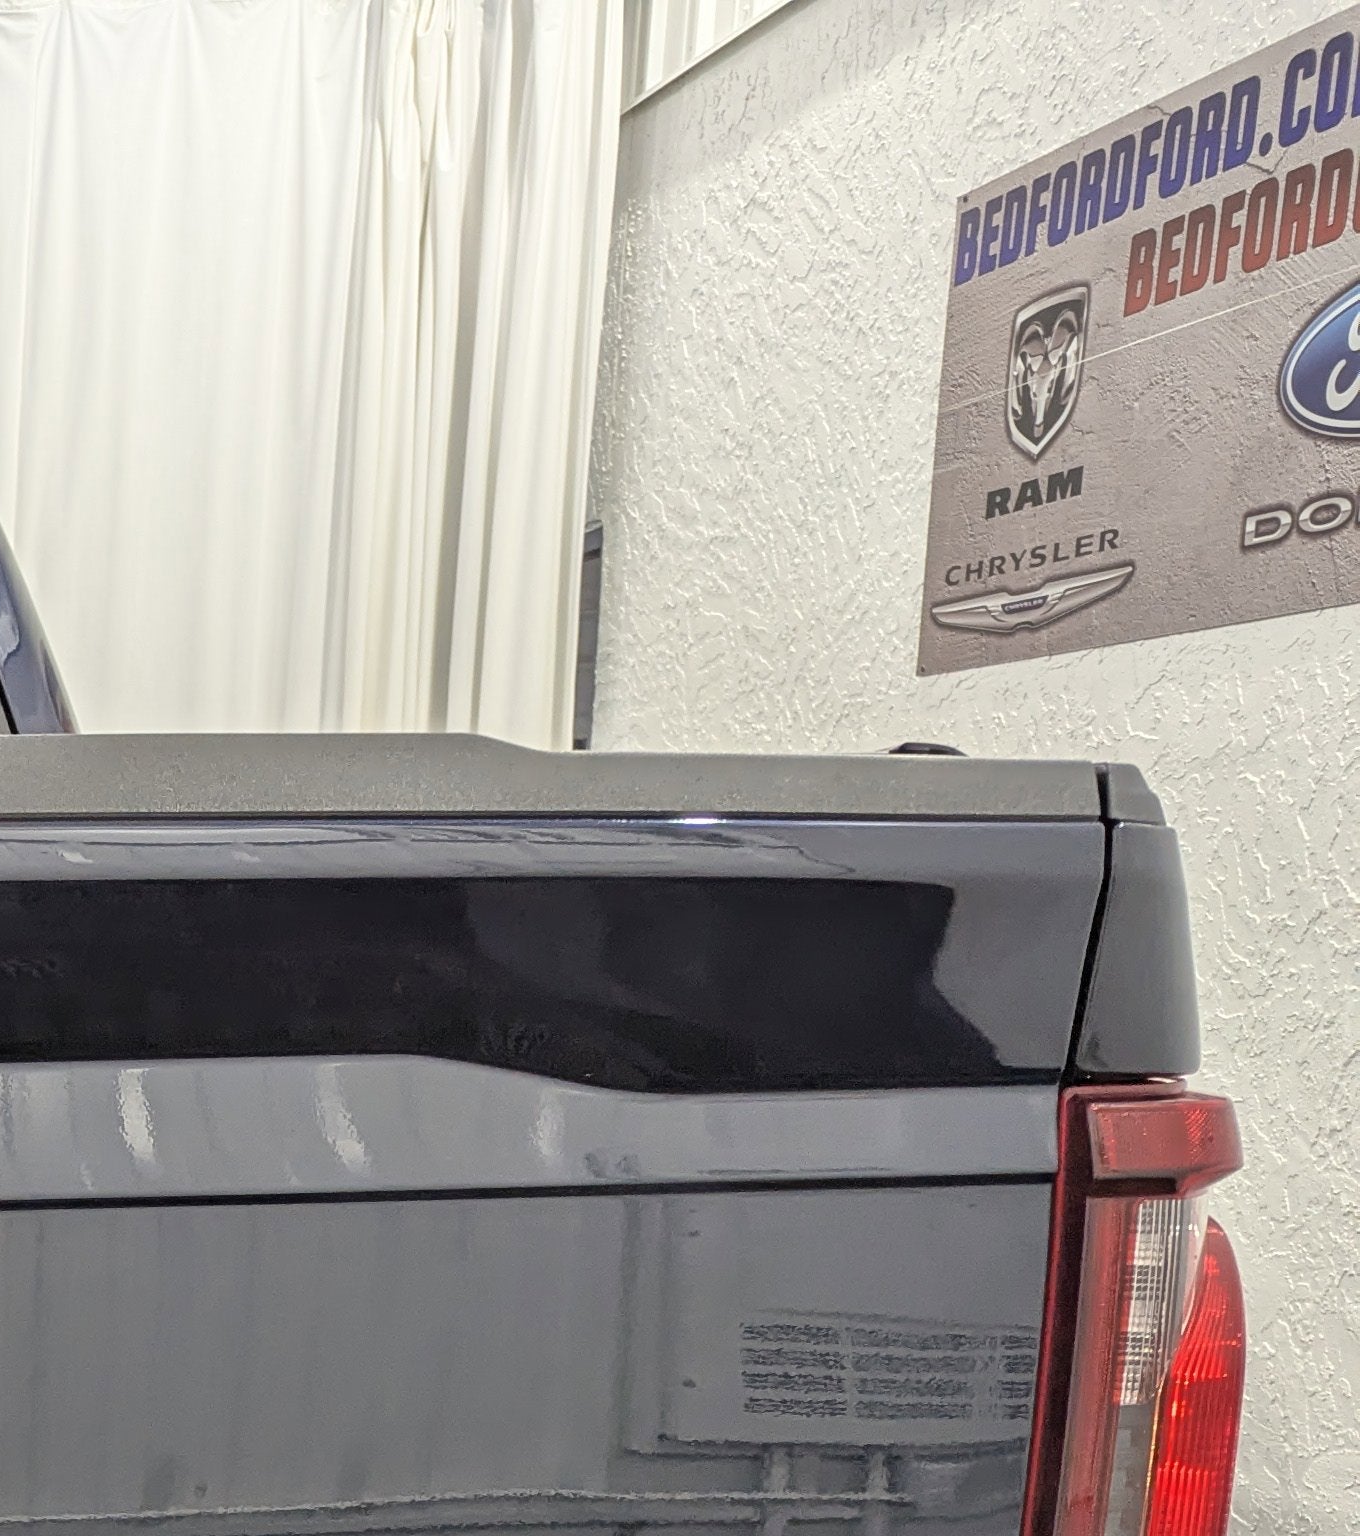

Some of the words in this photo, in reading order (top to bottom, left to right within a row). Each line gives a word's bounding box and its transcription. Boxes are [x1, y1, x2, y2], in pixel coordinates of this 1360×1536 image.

[953, 31, 1360, 287] BEDFORDFORD.CO
[1123, 148, 1360, 317] BEDFORD
[985, 466, 1084, 520] RAM
[1243, 497, 1360, 547] DO
[944, 528, 1120, 586] CHRYSLER
